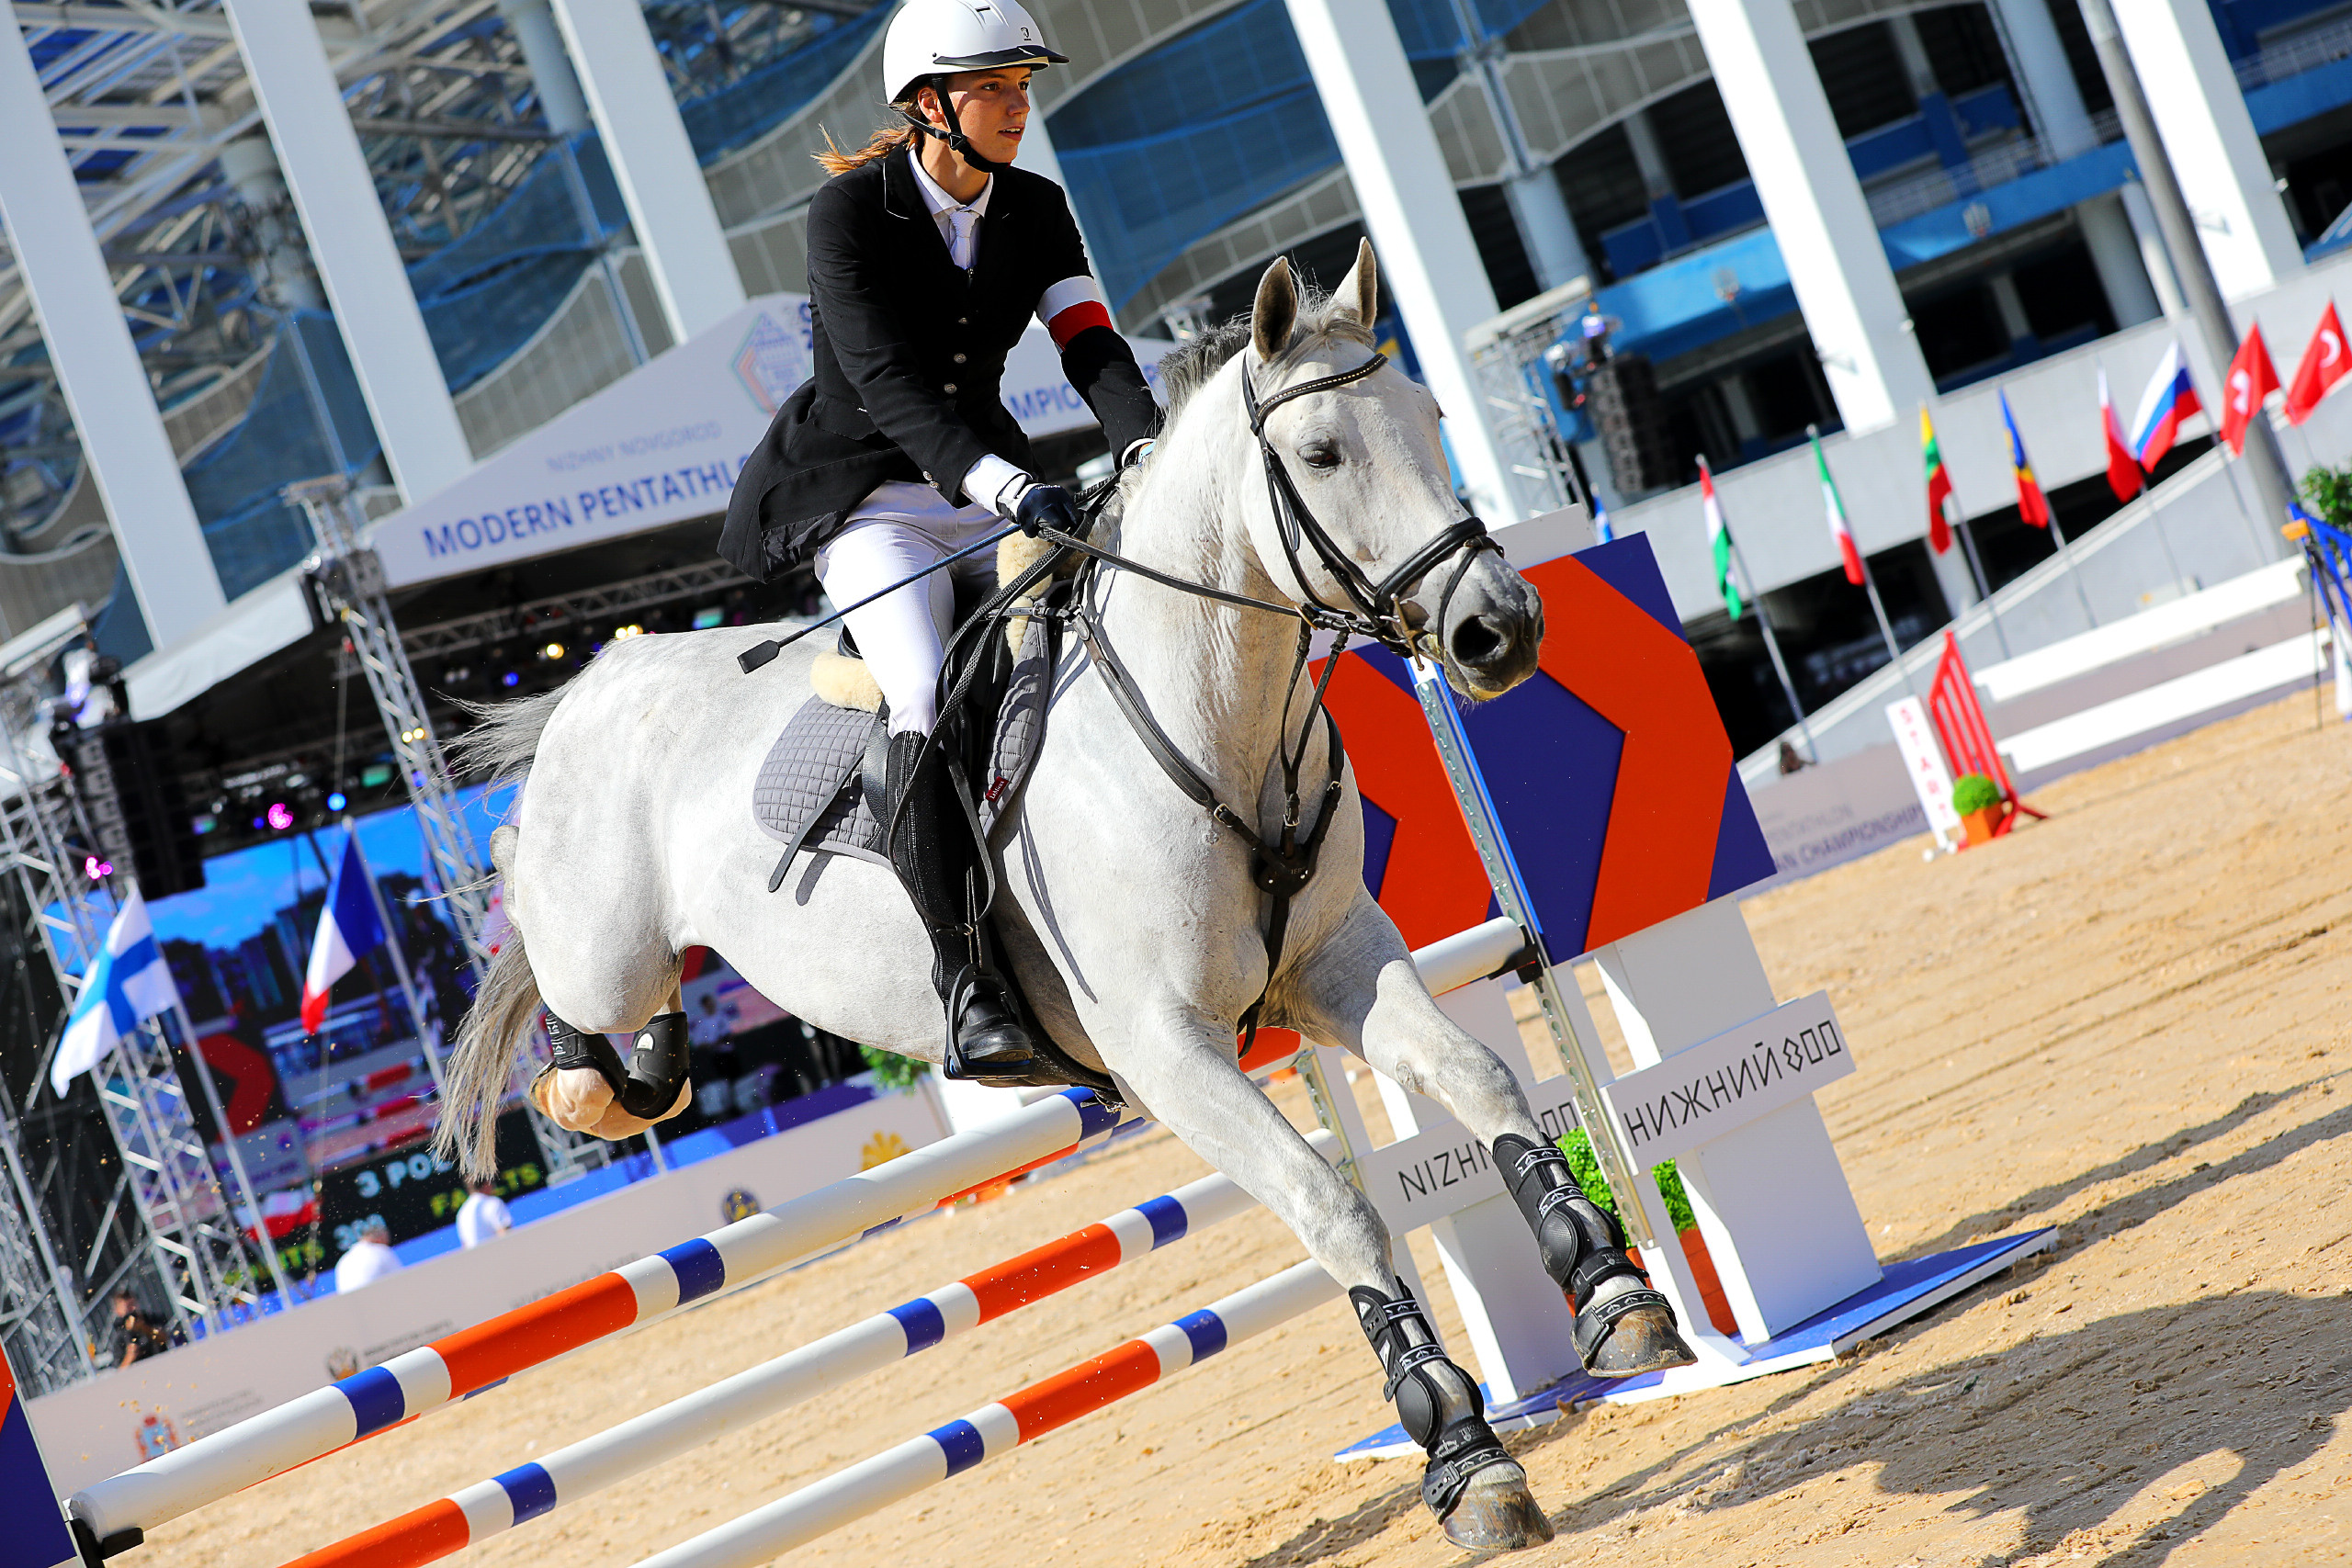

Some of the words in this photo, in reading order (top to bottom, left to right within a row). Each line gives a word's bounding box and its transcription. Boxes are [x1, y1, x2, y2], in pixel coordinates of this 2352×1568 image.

[423, 496, 574, 558] MODERN
[356, 1169, 381, 1199] 3
[1397, 1139, 1493, 1202] NIZHN
